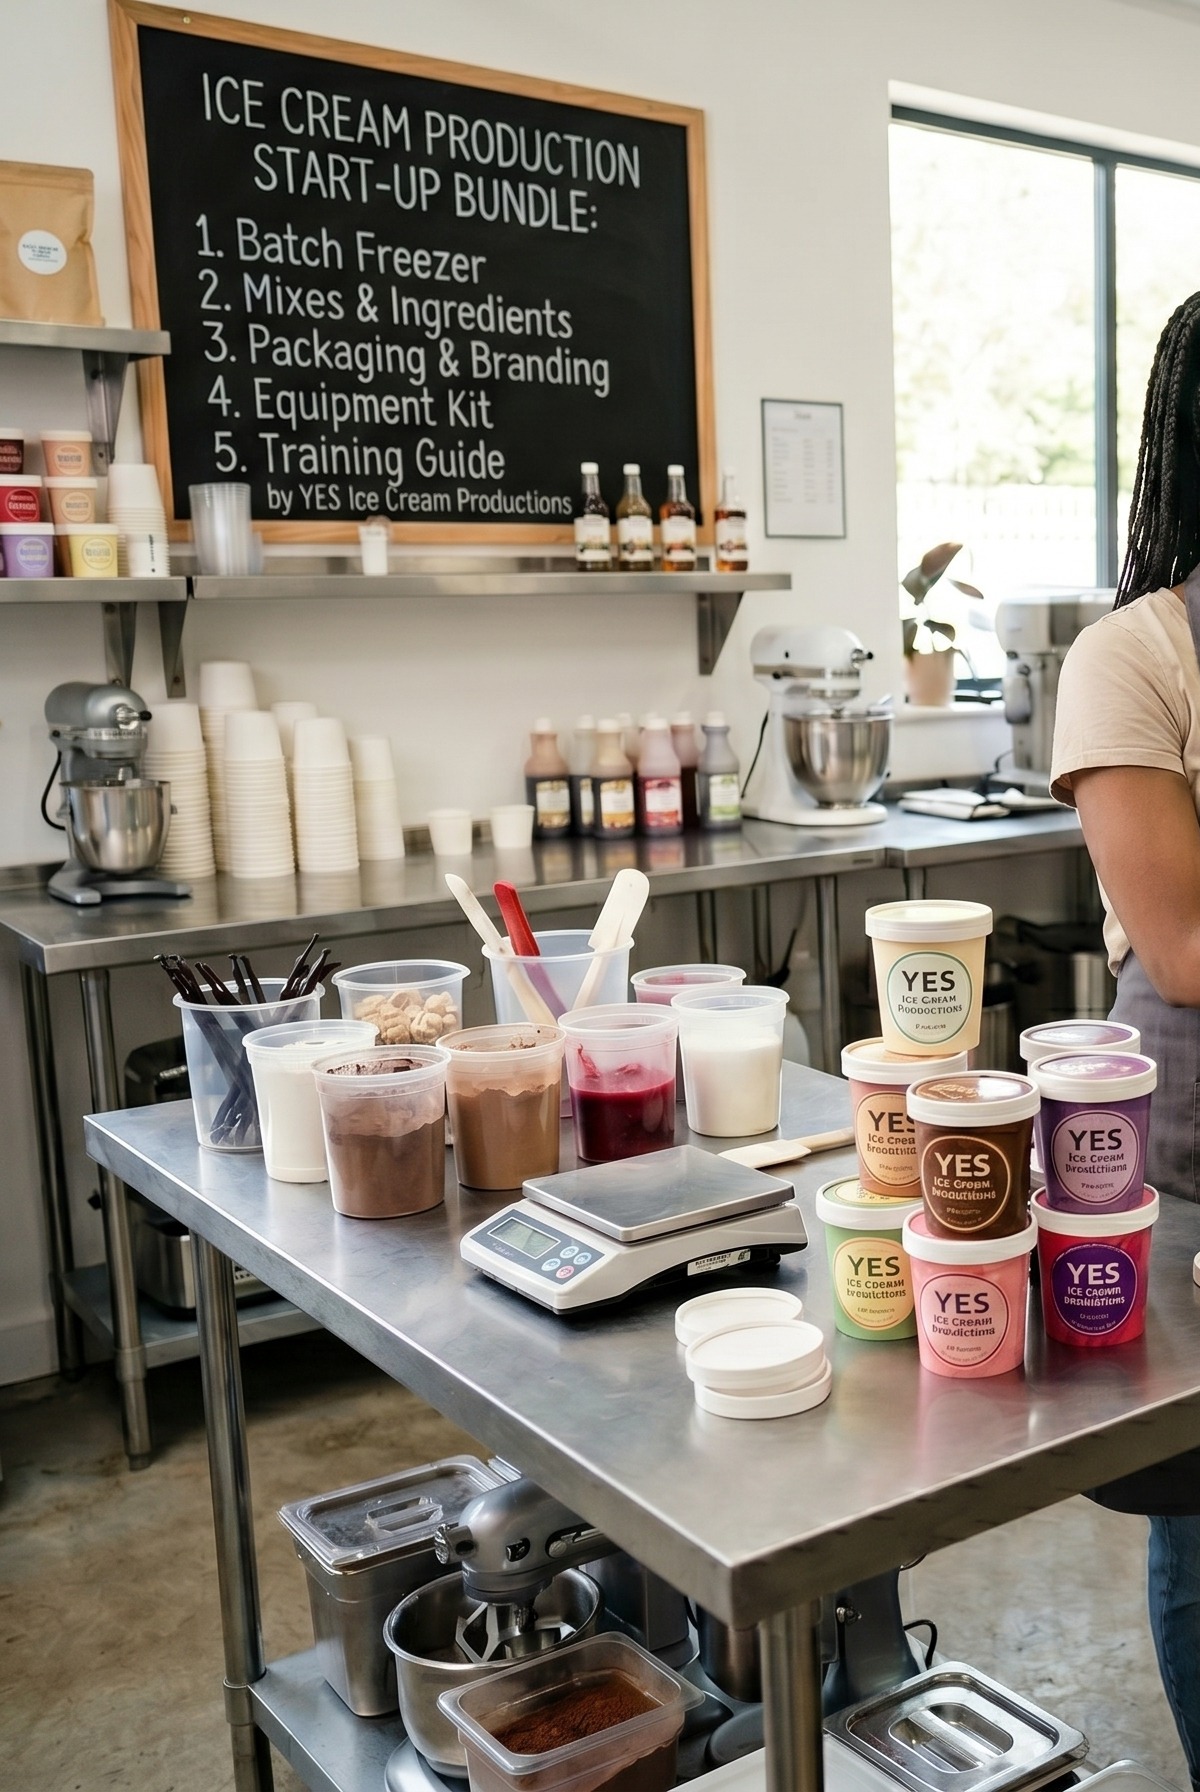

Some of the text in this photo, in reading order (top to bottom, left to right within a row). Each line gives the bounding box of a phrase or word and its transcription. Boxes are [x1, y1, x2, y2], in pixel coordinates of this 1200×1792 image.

[203, 73, 639, 187] ICE CREAM PRODUCTION
[254, 144, 597, 233] START-UP BUNDLE:
[196, 214, 486, 283] 1. Batch Freezer
[199, 269, 572, 339] 2. Mixes & Ingredients
[203, 321, 609, 397] 3. Packaging & Branding
[208, 375, 493, 432] 4. Equipment Kit
[215, 432, 504, 487] 5. Training Guide
[267, 483, 571, 515] by YES Ice Cream Productions
[901, 970, 955, 992] YES
[902, 995, 918, 1004] ICE
[867, 1110, 916, 1133] YES
[1068, 1129, 1122, 1151] YES
[934, 1152, 991, 1177] YES
[934, 1176, 950, 1188] ICE
[847, 1254, 900, 1277] YES
[1066, 1262, 1120, 1285] YES
[934, 1290, 990, 1314] YES
[1067, 1286, 1083, 1296] ICE
[934, 1314, 949, 1325] ICE
